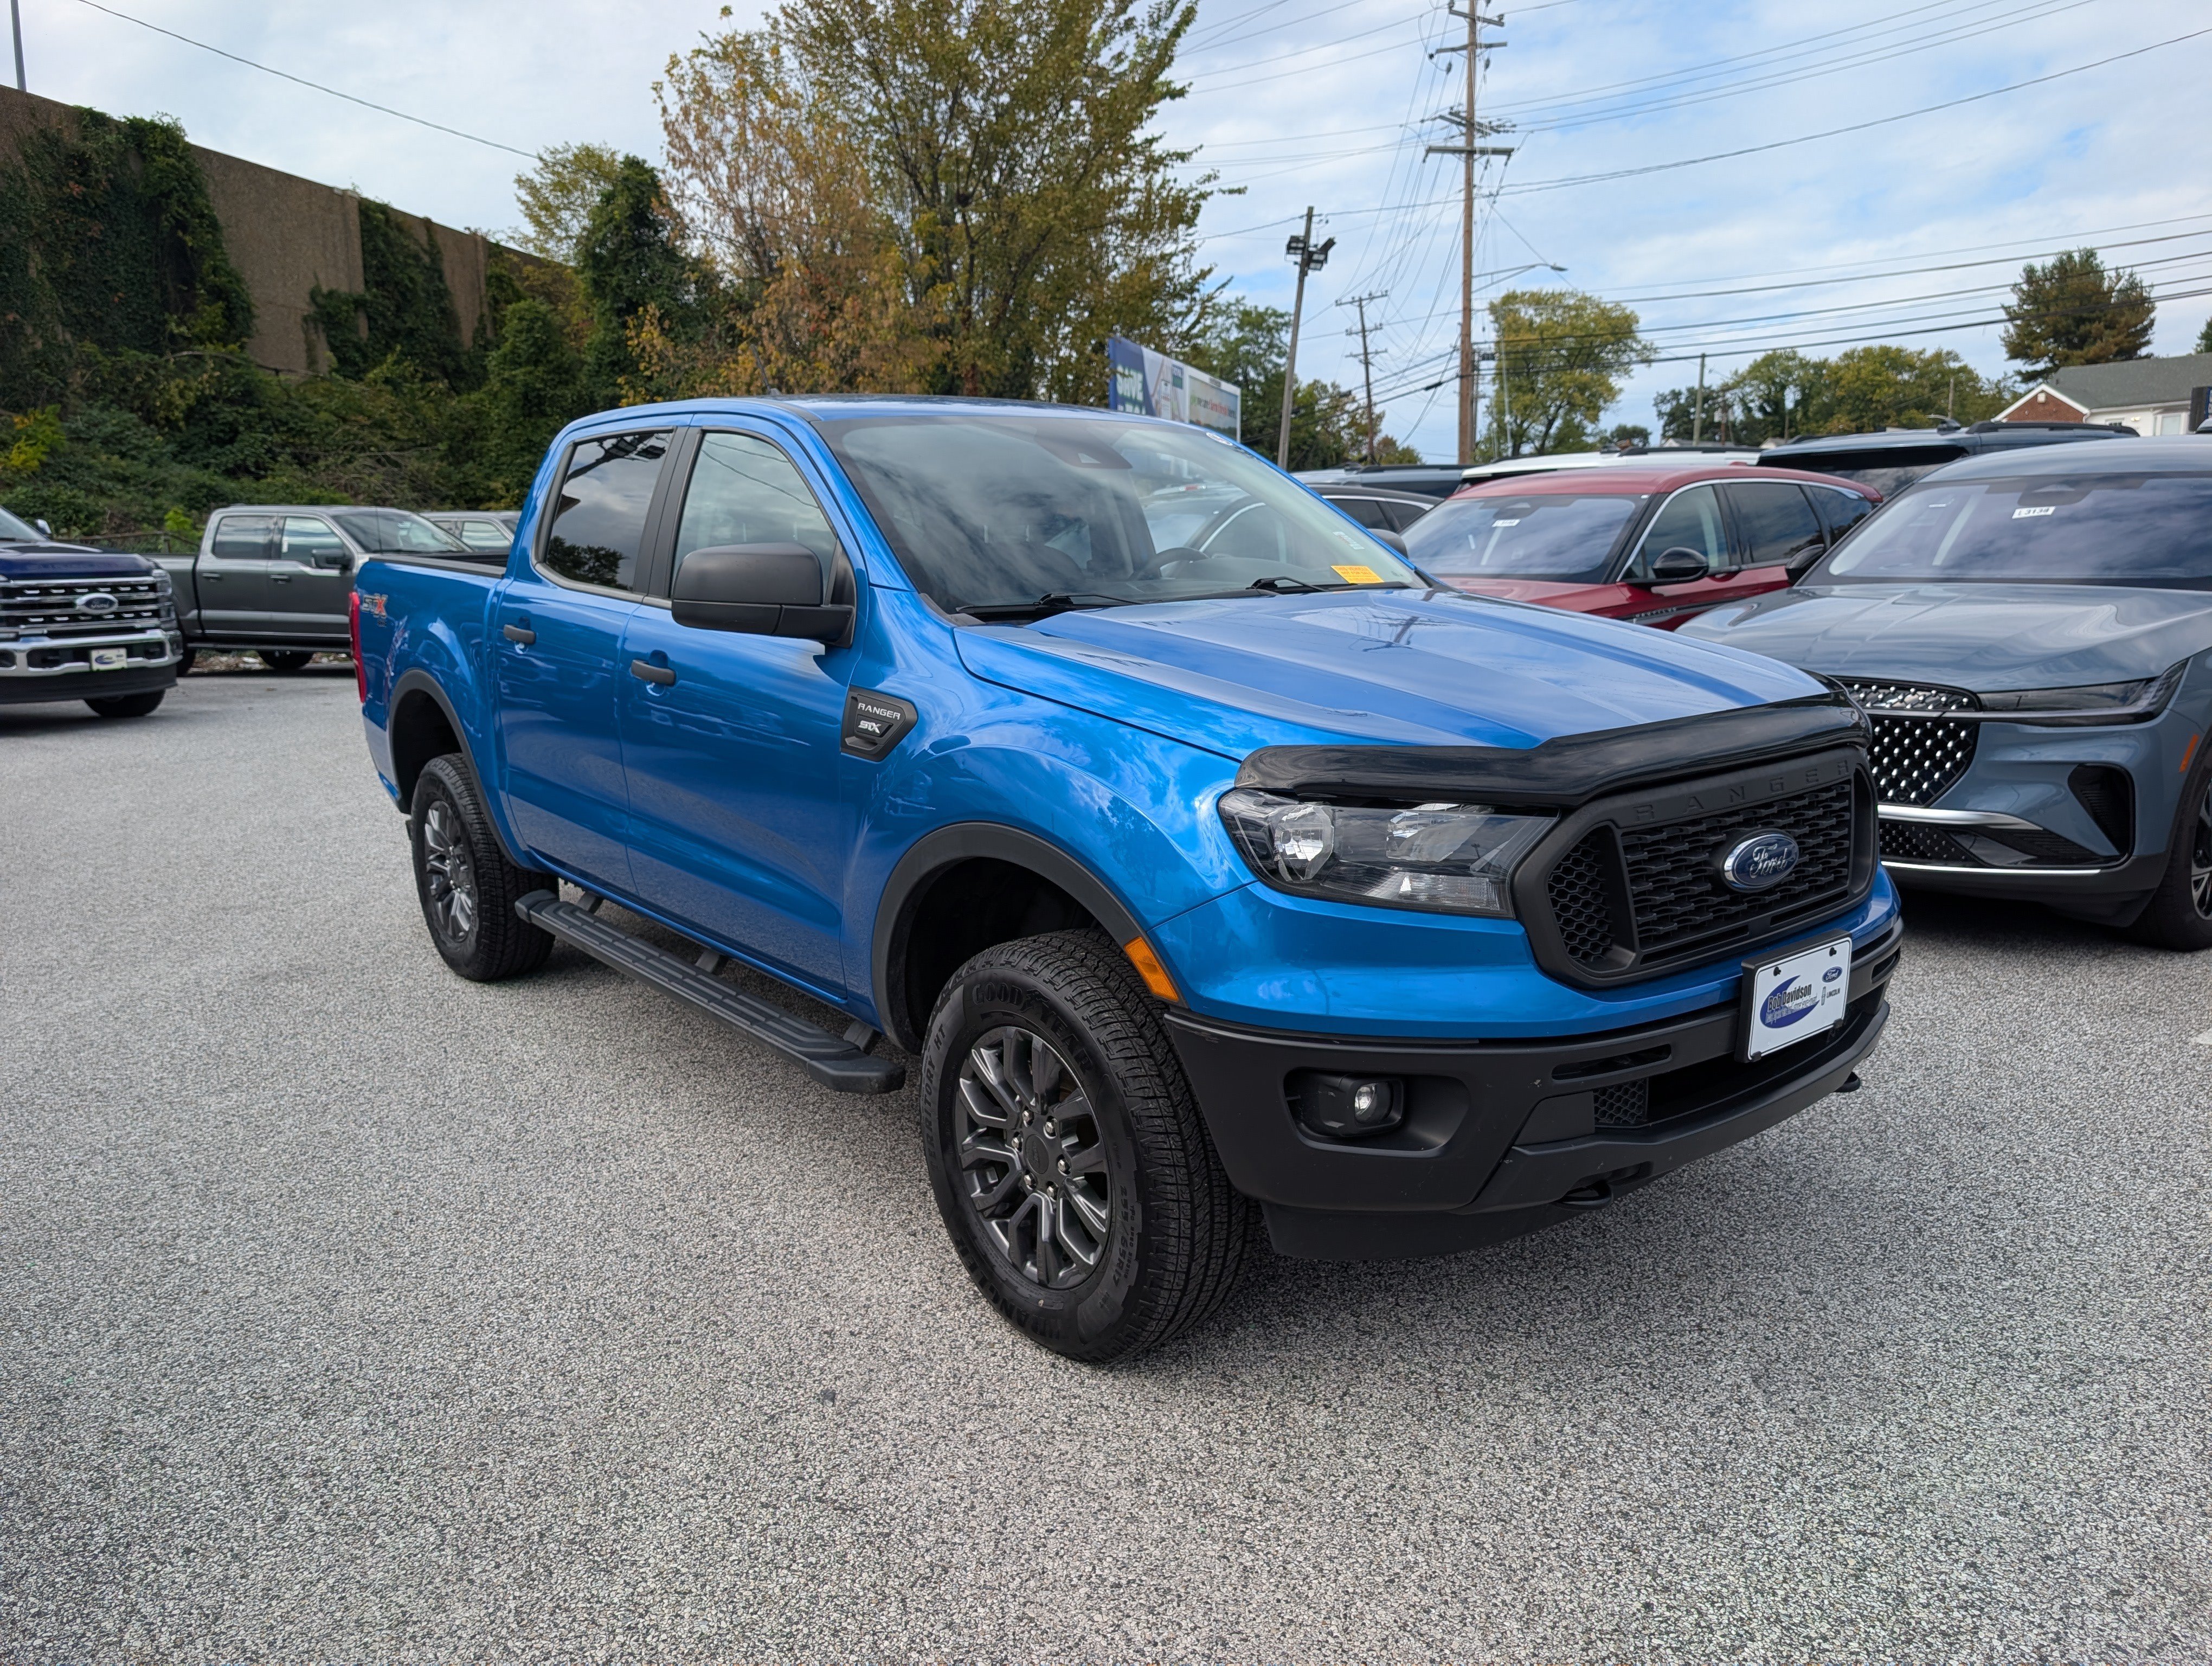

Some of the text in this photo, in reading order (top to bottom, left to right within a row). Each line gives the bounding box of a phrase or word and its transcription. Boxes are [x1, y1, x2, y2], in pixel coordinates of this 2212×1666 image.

[858, 702, 901, 720] RANGER
[858, 720, 882, 734] STX
[1632, 760, 1849, 822] RANGER
[1749, 842, 1791, 879] Ford
[1825, 969, 1839, 981] Ford
[1768, 994, 1782, 1011] Bob
[1782, 983, 1812, 1005] Davidson
[1826, 988, 1841, 998] LINCOLN
